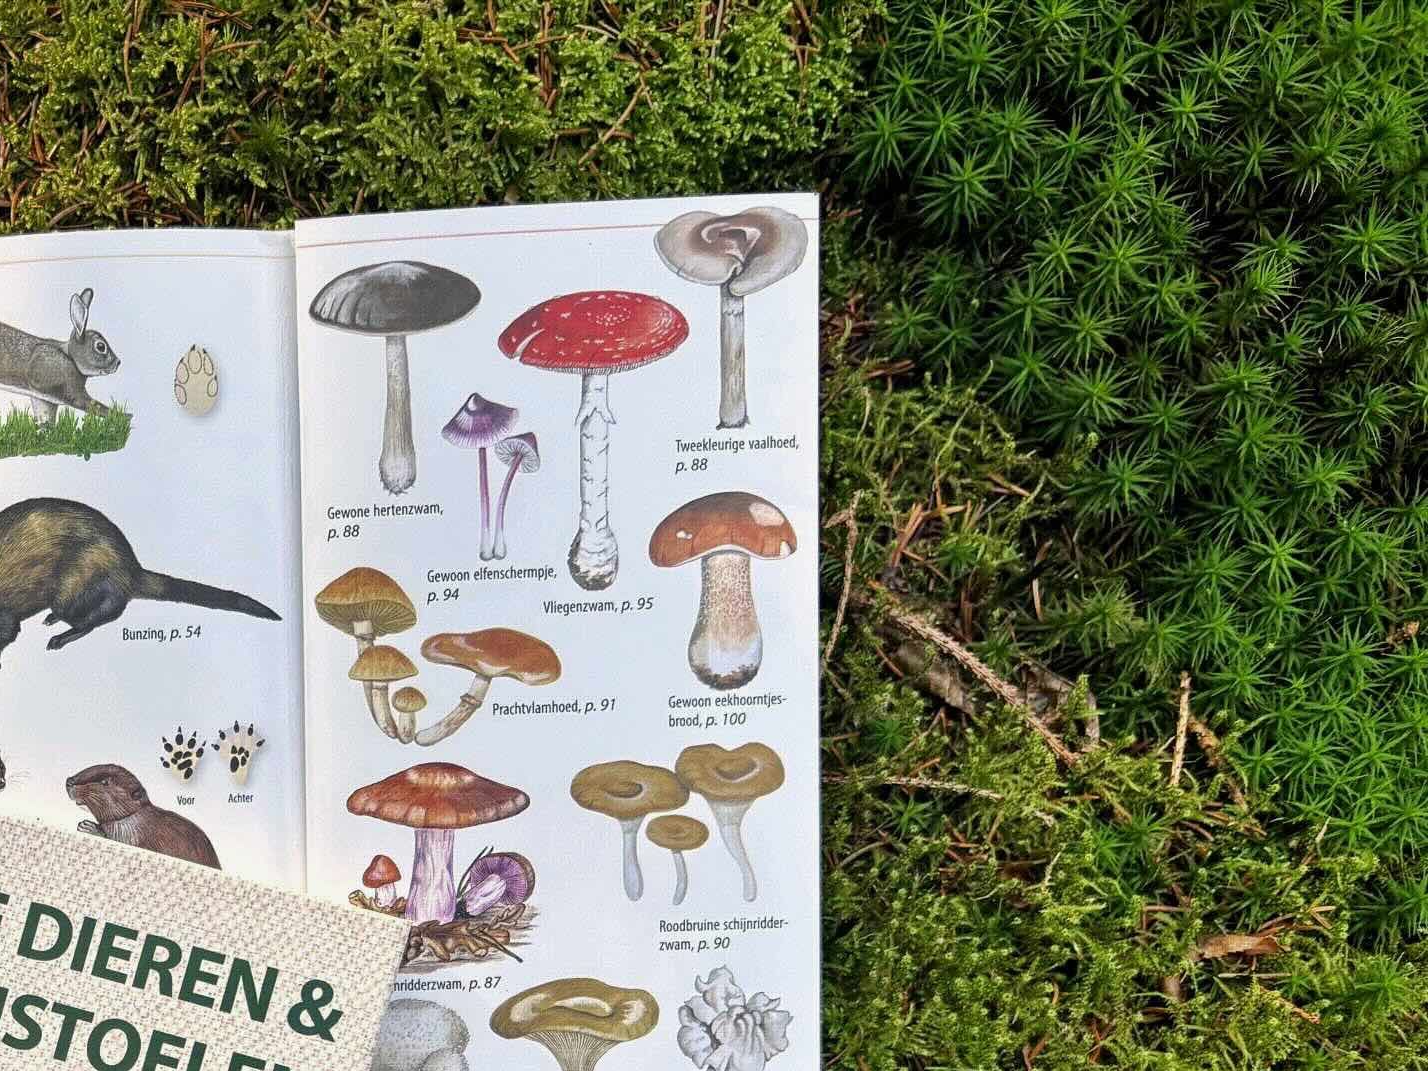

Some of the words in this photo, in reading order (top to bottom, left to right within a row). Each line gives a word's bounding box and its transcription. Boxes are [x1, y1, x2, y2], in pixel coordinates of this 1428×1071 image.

[676, 437, 746, 454] Tweekleurige
[749, 435, 799, 452] vaalhoed,
[675, 460, 689, 473] p.
[690, 458, 708, 471] 88
[327, 505, 370, 520] Gewone
[373, 502, 444, 518] hertenzwam,
[327, 527, 341, 541] p.
[343, 524, 360, 538] 88
[427, 568, 470, 583] Gewoon
[473, 566, 557, 582] elfenschermpje,
[426, 591, 441, 604] p.
[442, 588, 460, 601] 94
[543, 599, 619, 616] Vliegenzwam,
[620, 600, 635, 614] p.
[636, 597, 654, 610] 95
[122, 627, 167, 643] Bunzing,
[169, 628, 183, 642] p.
[185, 626, 201, 638] 54
[492, 700, 583, 716] Prachtvlamhoed,
[584, 701, 598, 715] p.
[600, 698, 616, 711] 91
[668, 696, 711, 708] Gewoon
[715, 693, 787, 708] eekhoorntjes-
[668, 714, 702, 728] brood,
[706, 716, 718, 728] p.
[723, 712, 746, 725] 100
[176, 795, 195, 806] Voor
[228, 792, 254, 804] Achter
[659, 919, 719, 933] Roodbruine
[723, 917, 789, 934] schijnridder-
[659, 939, 694, 953] zwam,
[697, 940, 711, 953] p.
[713, 937, 730, 949] 90
[16, 903, 280, 1023] DIEREN
[286, 978, 343, 1042] &
[469, 979, 480, 992] p.
[484, 976, 501, 989] 87
